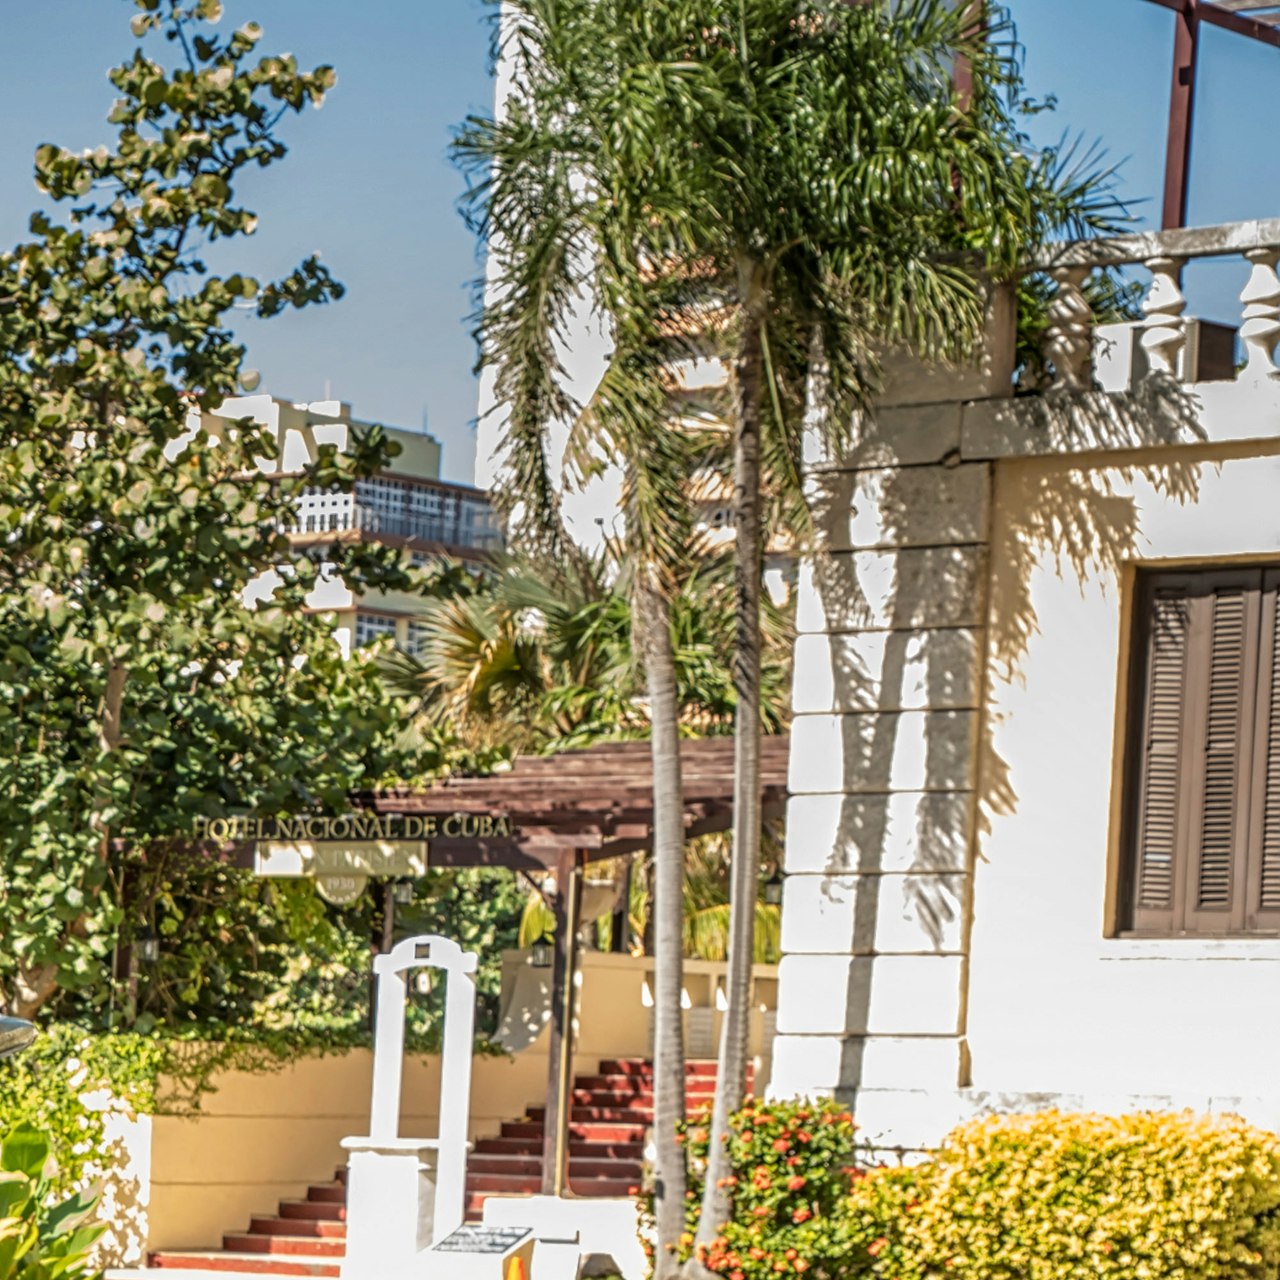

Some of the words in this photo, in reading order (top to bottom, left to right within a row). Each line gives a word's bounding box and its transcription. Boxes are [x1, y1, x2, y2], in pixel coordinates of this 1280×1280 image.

[192, 815, 270, 841] HOTEL
[273, 815, 400, 839] NACIONAL
[405, 815, 438, 838] DE
[443, 815, 510, 838] CUBA
